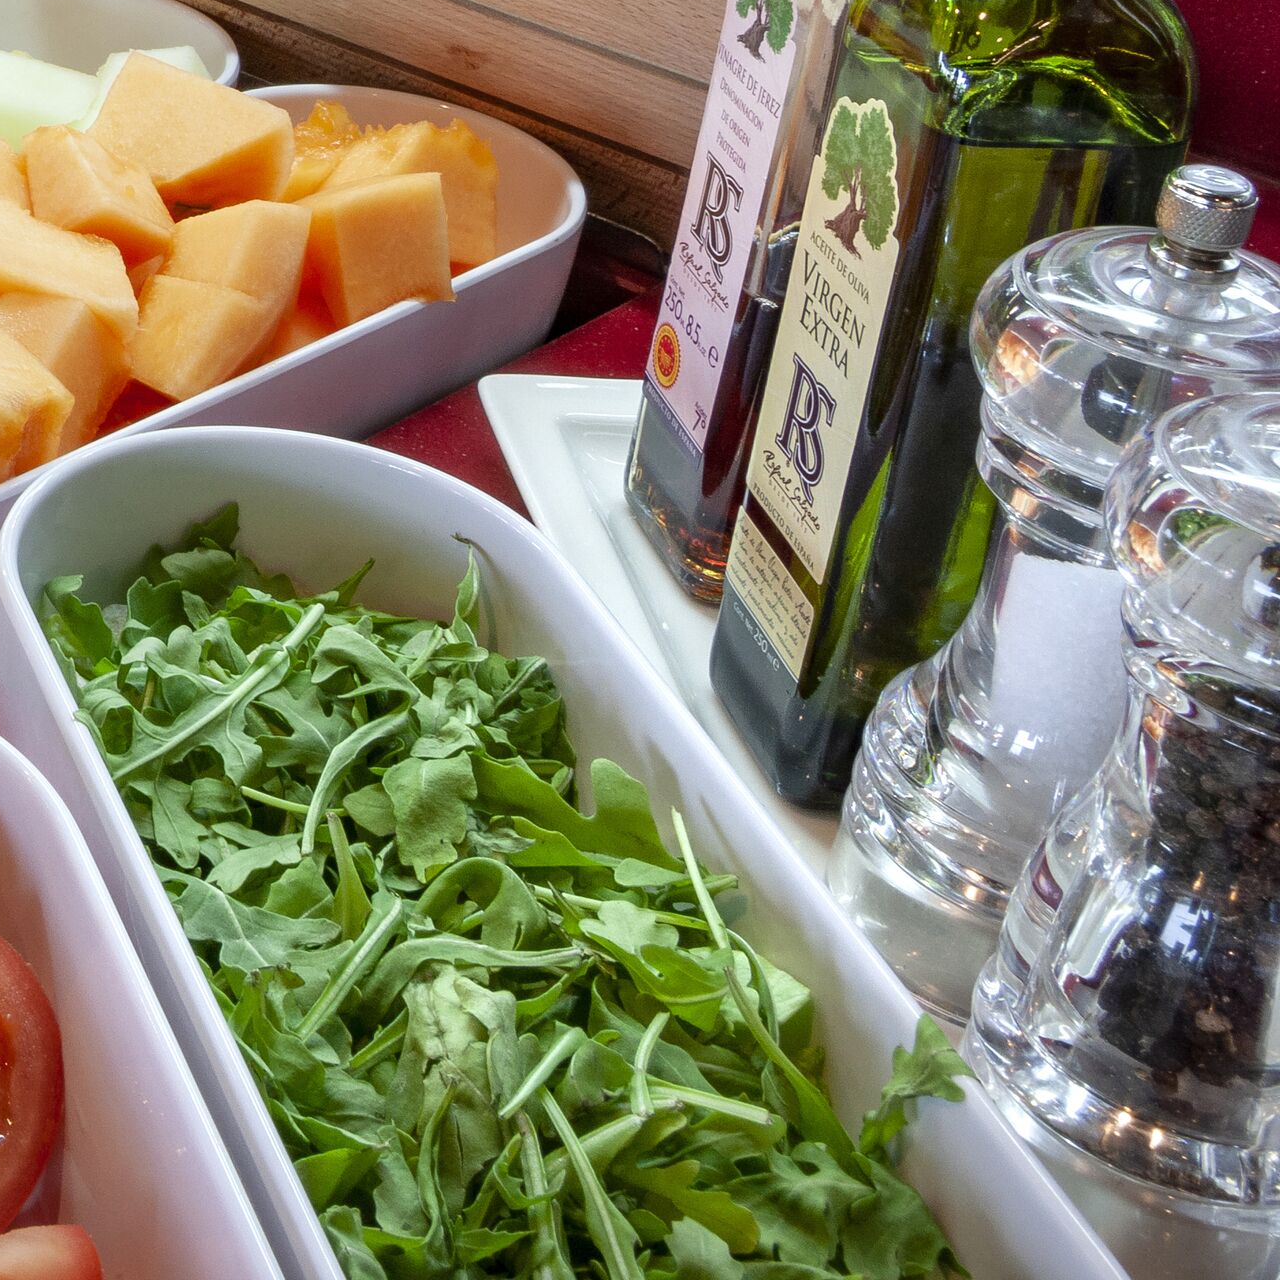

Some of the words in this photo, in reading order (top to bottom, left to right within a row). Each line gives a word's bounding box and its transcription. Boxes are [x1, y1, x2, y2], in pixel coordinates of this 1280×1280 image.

[746, 74, 759, 96] DE
[756, 84, 782, 119] JEREZ
[720, 109, 731, 124] DE
[729, 115, 751, 148] ORIGEN
[715, 130, 748, 175] PROTEGIDA
[809, 231, 836, 265] ACEITE
[836, 257, 847, 278] DE
[847, 271, 871, 305] OLIVA
[664, 285, 684, 321] 250
[803, 248, 866, 350] VIRGEN
[799, 292, 849, 380] EXTRA
[752, 481, 785, 531] PRODUCTO
[784, 521, 794, 543] DE
[793, 534, 816, 572] ESPAÑA
[753, 624, 769, 654] 250
